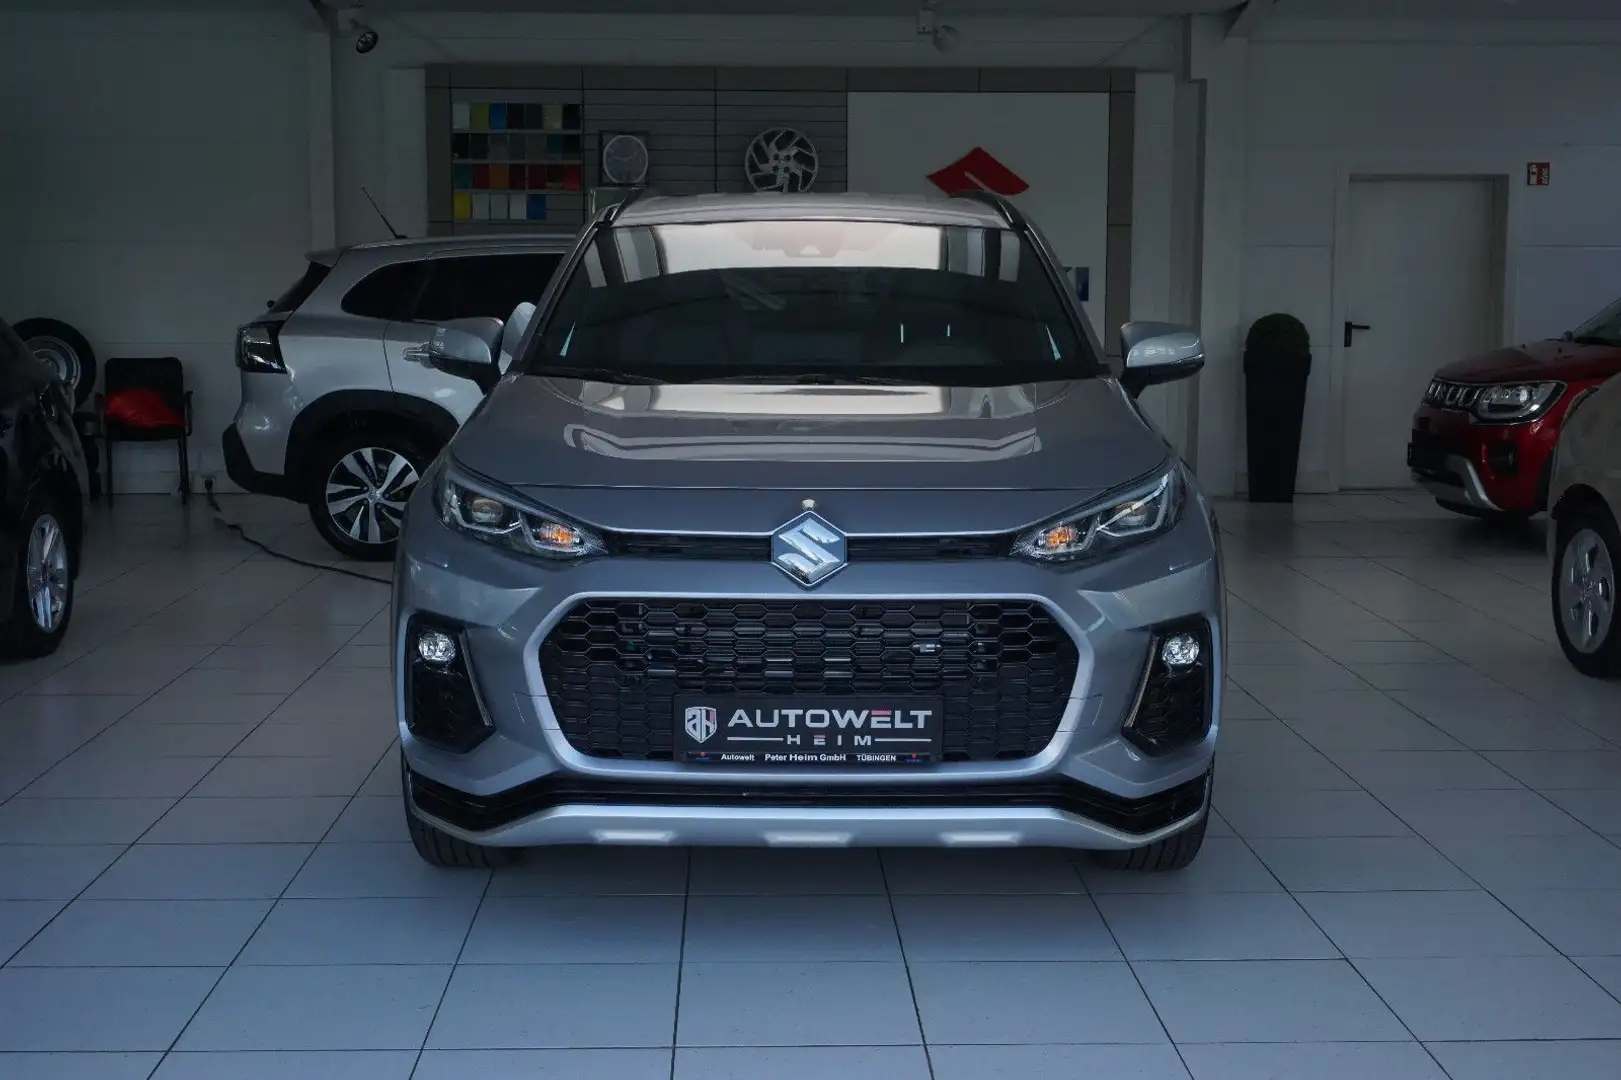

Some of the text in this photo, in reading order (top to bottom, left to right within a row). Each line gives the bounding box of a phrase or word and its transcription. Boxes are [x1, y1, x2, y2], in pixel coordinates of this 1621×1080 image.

[727, 709, 932, 729] AUTOWELT
[786, 734, 872, 746] HEIM
[720, 753, 755, 761] Autowelt
[764, 753, 787, 761] Peter
[789, 753, 818, 761] Heim
[819, 753, 846, 762] GmbH
[856, 753, 897, 762] TÜBINGEN
